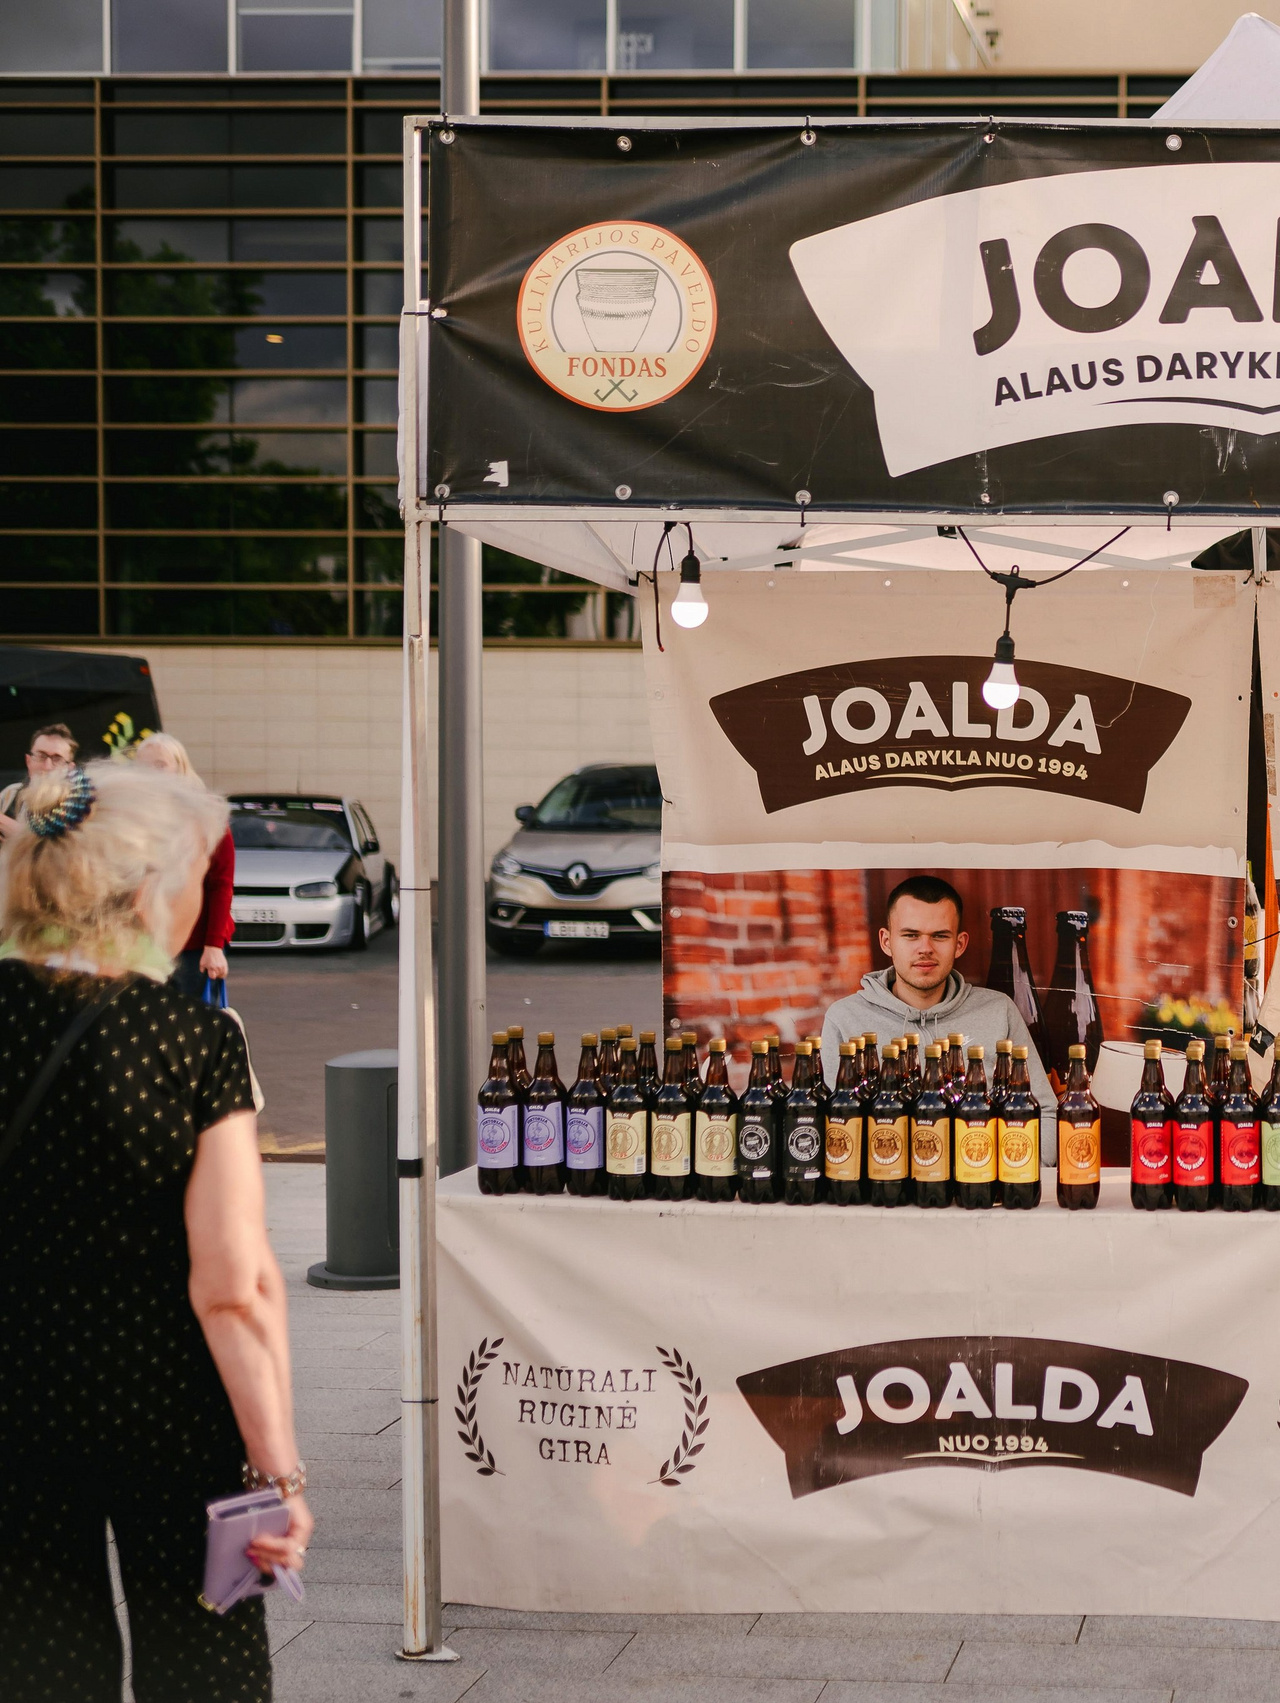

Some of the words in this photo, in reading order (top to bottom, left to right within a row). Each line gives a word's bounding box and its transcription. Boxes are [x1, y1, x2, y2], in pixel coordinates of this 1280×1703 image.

[527, 229, 640, 354] KULINARIJOS
[650, 236, 707, 354] PAVELDO
[566, 356, 668, 378] FONDAS
[994, 357, 1125, 406] ALAUS
[802, 681, 1102, 756] JOALDA
[815, 755, 881, 780] ALAUS
[885, 749, 982, 769] DARYKLA
[985, 752, 1034, 769] NUO
[1038, 756, 1089, 780] 1994
[502, 1361, 657, 1393] NATŪRALI
[518, 1398, 638, 1429] RUGINĖ
[835, 1361, 1154, 1436] JOALDA
[538, 1437, 612, 1465] GIRA
[938, 1434, 990, 1453] NUO
[994, 1435, 1049, 1453] 1994
